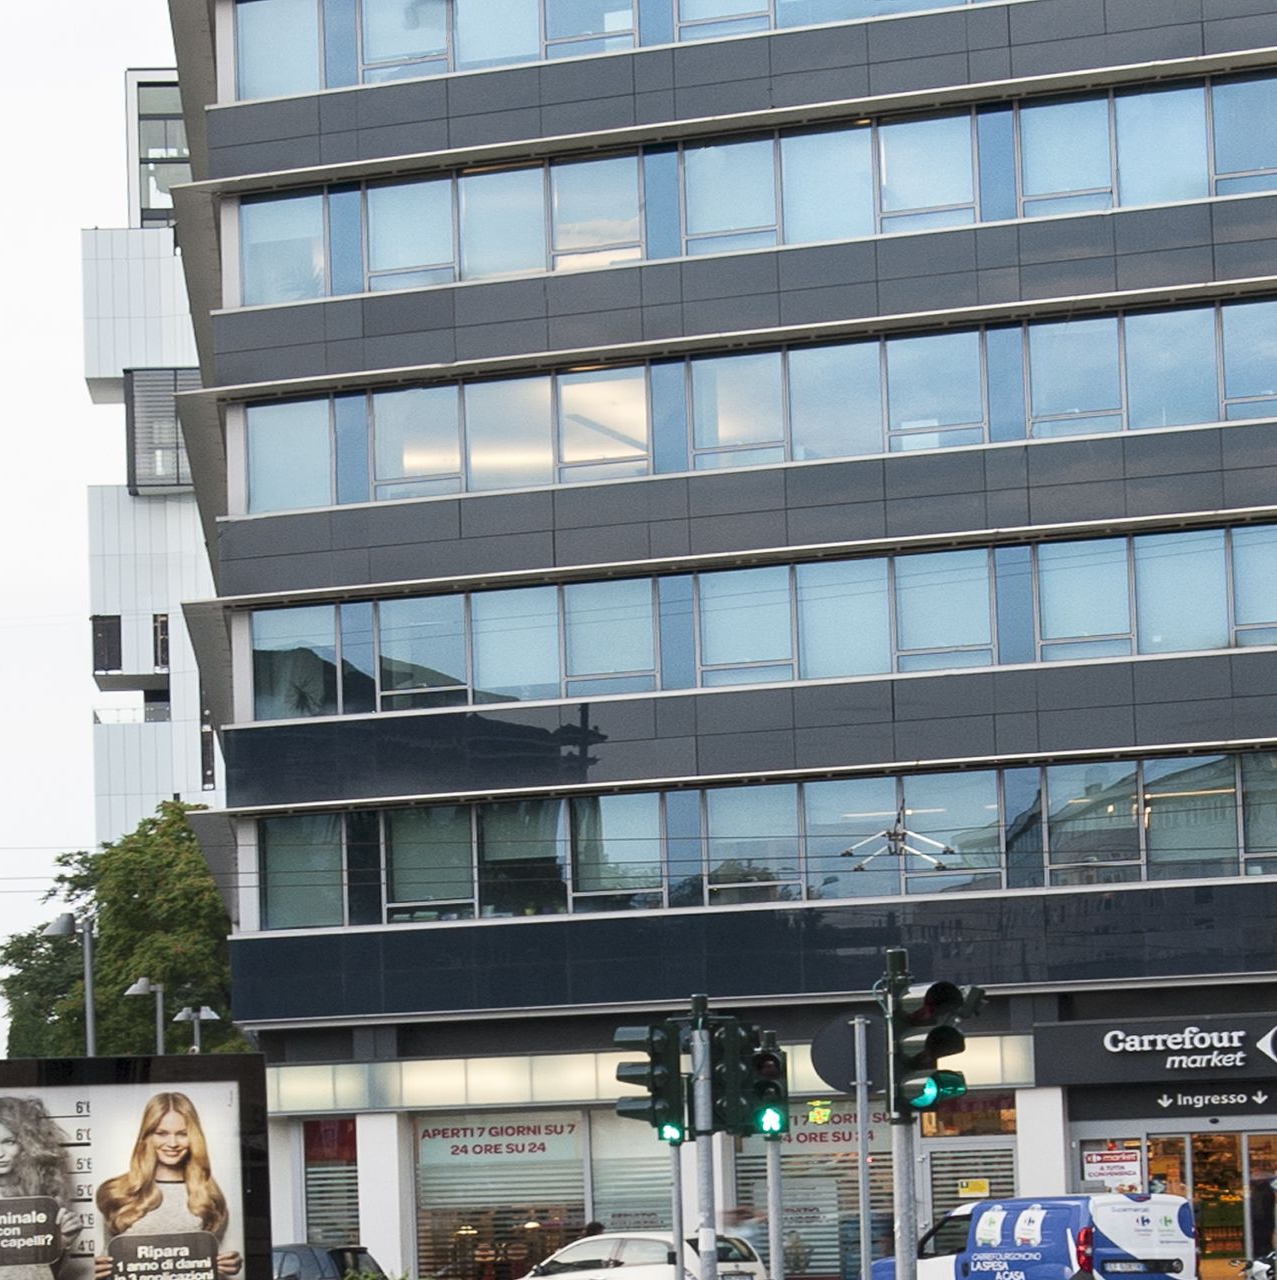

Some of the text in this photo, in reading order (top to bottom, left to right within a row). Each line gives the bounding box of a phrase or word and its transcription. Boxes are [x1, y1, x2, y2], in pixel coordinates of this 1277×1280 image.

[1103, 1027, 1247, 1052] Carrefour
[1165, 1051, 1247, 1069] market
[422, 1124, 576, 1140] APERTI 7 GIORNI SU 7
[796, 1131, 829, 1144] ORE
[831, 1131, 852, 1143] SU
[451, 1142, 547, 1156] 24 ORE SU 24
[0, 1234, 54, 1250] capelli?
[137, 1246, 190, 1261] Ripara
[117, 1257, 212, 1272] 1 anno di danni
[1002, 1271, 1025, 1280] CASA
